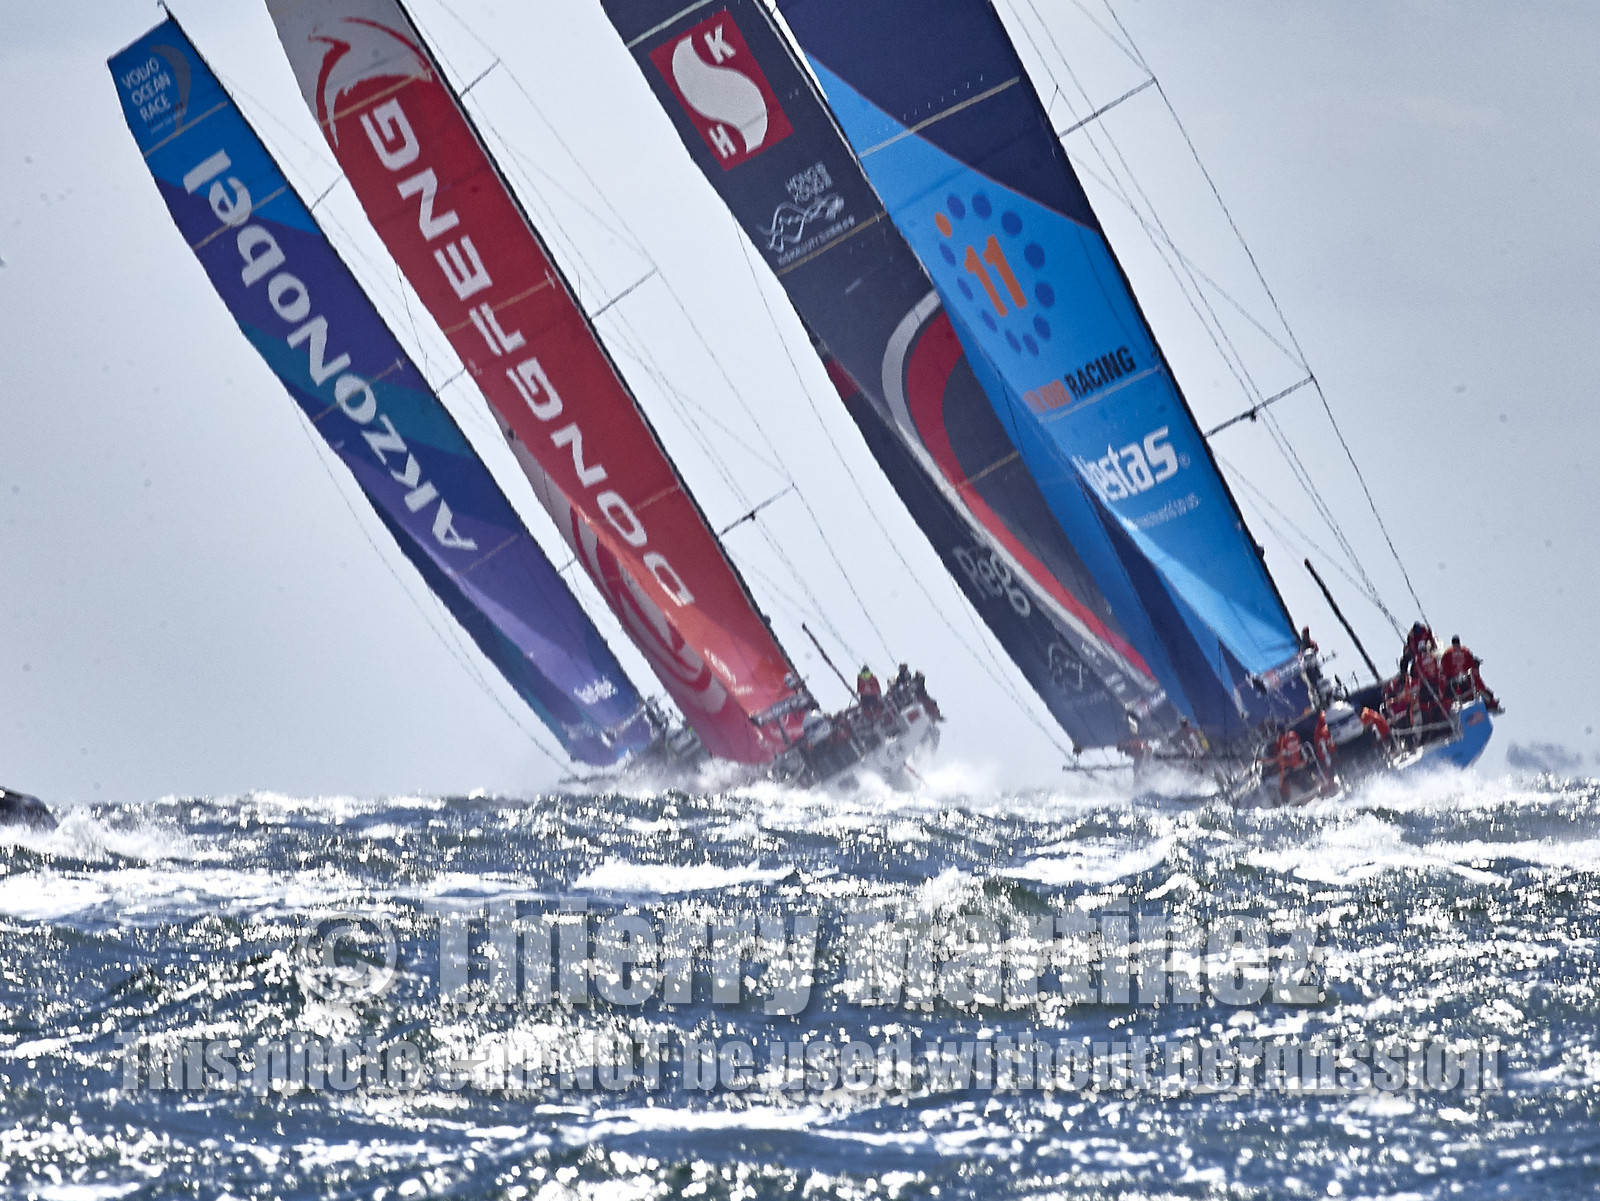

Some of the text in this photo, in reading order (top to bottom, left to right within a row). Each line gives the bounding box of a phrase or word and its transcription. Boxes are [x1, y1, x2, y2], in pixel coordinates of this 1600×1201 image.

[121, 57, 159, 90] VOLVO
[131, 72, 171, 106] OCEAN
[140, 95, 171, 123] RACE
[360, 98, 695, 606] DONGFENG
[1064, 346, 1136, 400] RACING
